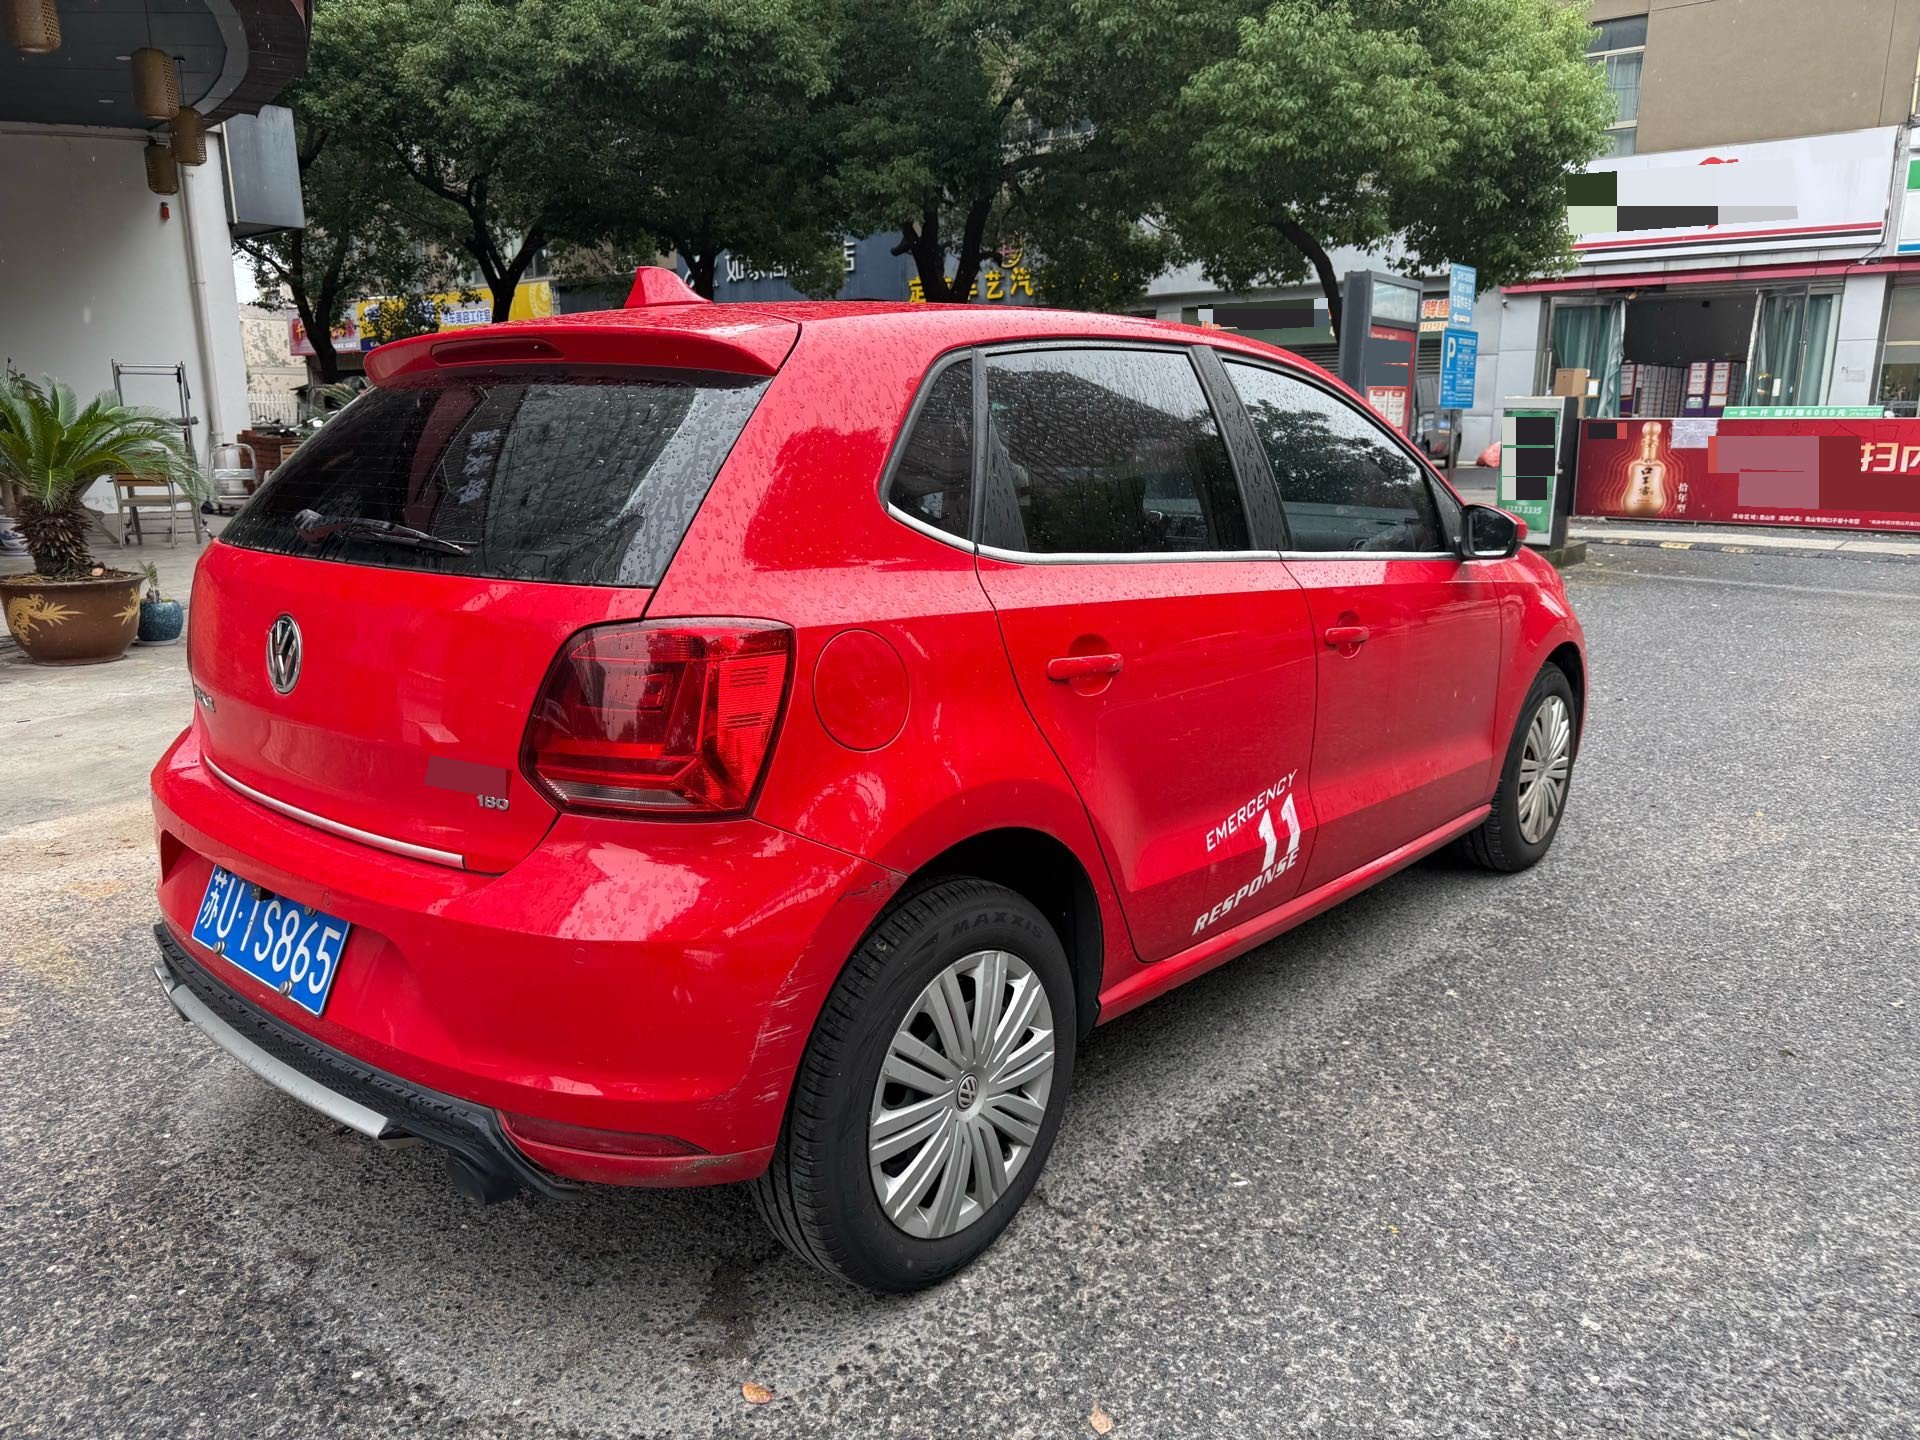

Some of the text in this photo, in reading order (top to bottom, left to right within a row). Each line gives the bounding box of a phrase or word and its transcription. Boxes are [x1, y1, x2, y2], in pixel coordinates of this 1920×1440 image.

[1446, 337, 1456, 368] P
[476, 794, 510, 811] 180
[1206, 768, 1298, 852] EMERGENCY
[1191, 847, 1300, 937] RESPONSE
[951, 911, 1044, 939] MAXXIS
